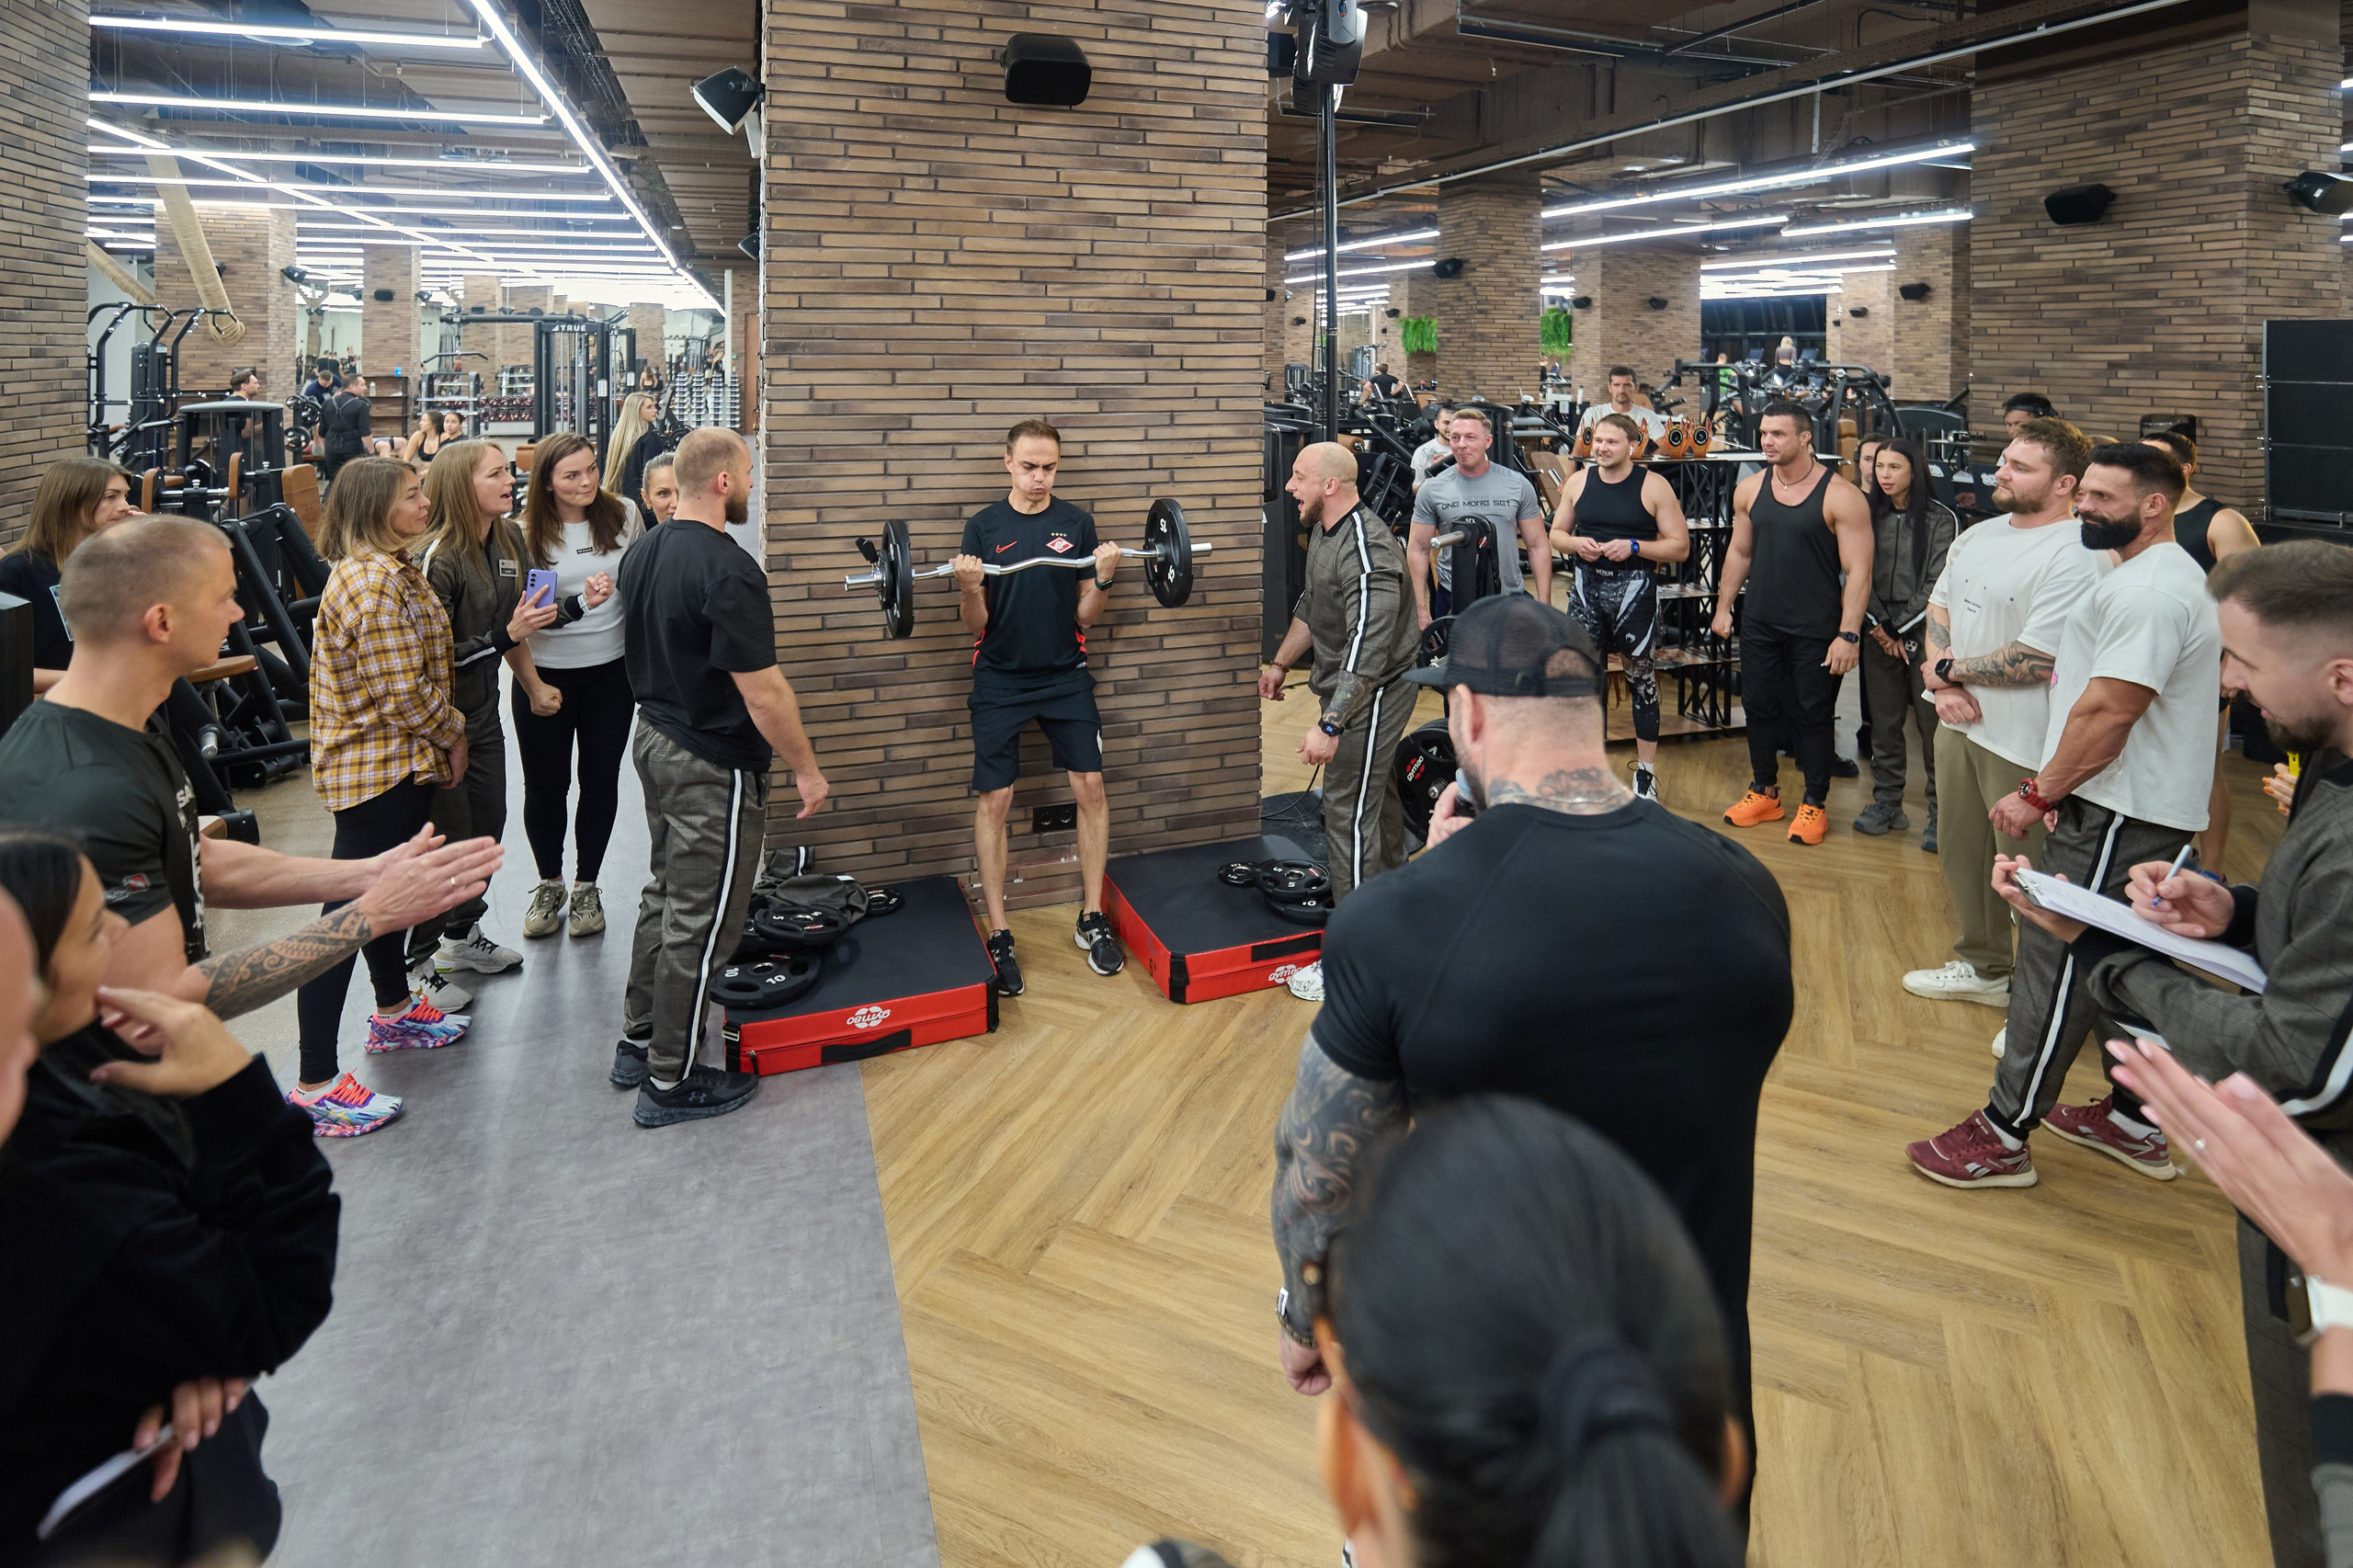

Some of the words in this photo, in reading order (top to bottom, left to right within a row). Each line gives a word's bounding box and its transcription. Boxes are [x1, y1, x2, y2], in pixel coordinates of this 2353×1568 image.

[560, 324, 586, 332] TRUE
[1441, 501, 1460, 510] ONE
[1596, 568, 1614, 577] VENUM
[724, 967, 739, 978] 10
[766, 974, 786, 984] 10
